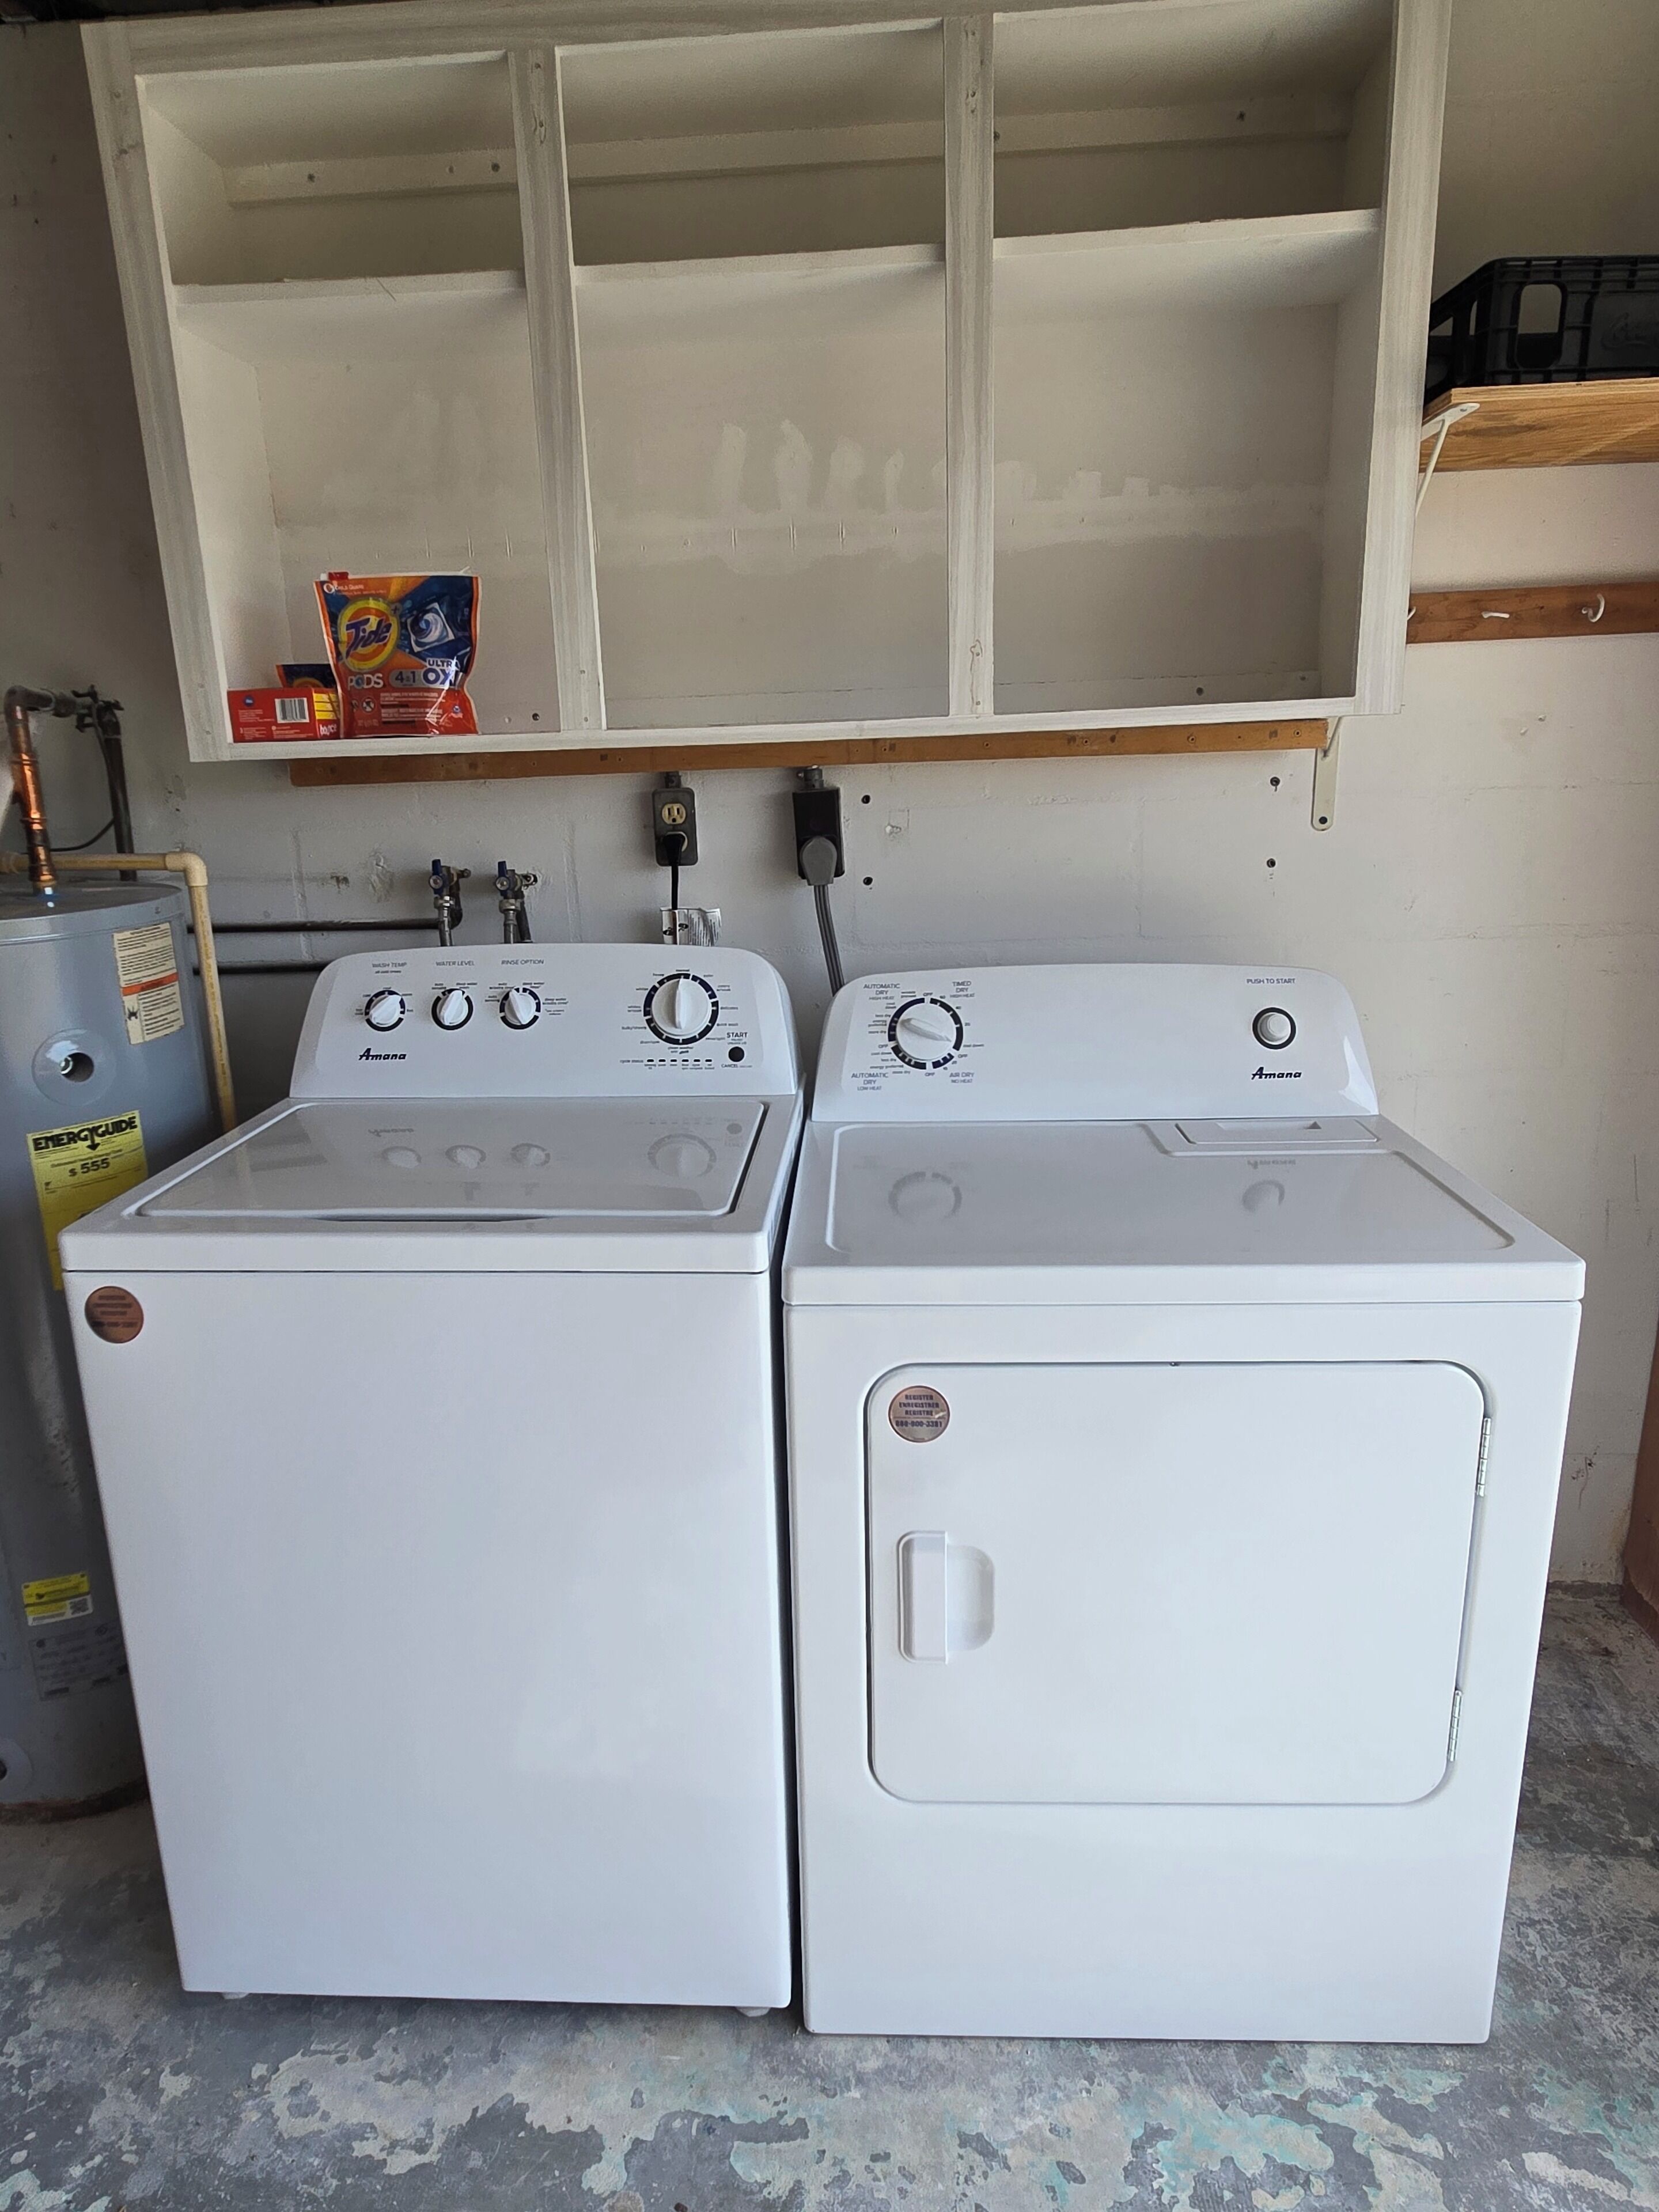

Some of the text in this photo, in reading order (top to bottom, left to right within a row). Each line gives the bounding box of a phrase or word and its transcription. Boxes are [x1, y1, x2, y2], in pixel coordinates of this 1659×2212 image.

[345, 617, 392, 660] Tide
[428, 658, 459, 667] ULTR
[348, 673, 384, 690] PODS
[358, 1047, 407, 1060] Amana
[1251, 1066, 1302, 1080] Amana
[32, 1116, 138, 1152] ENERGYGUIDE
[80, 1157, 111, 1174] 555
